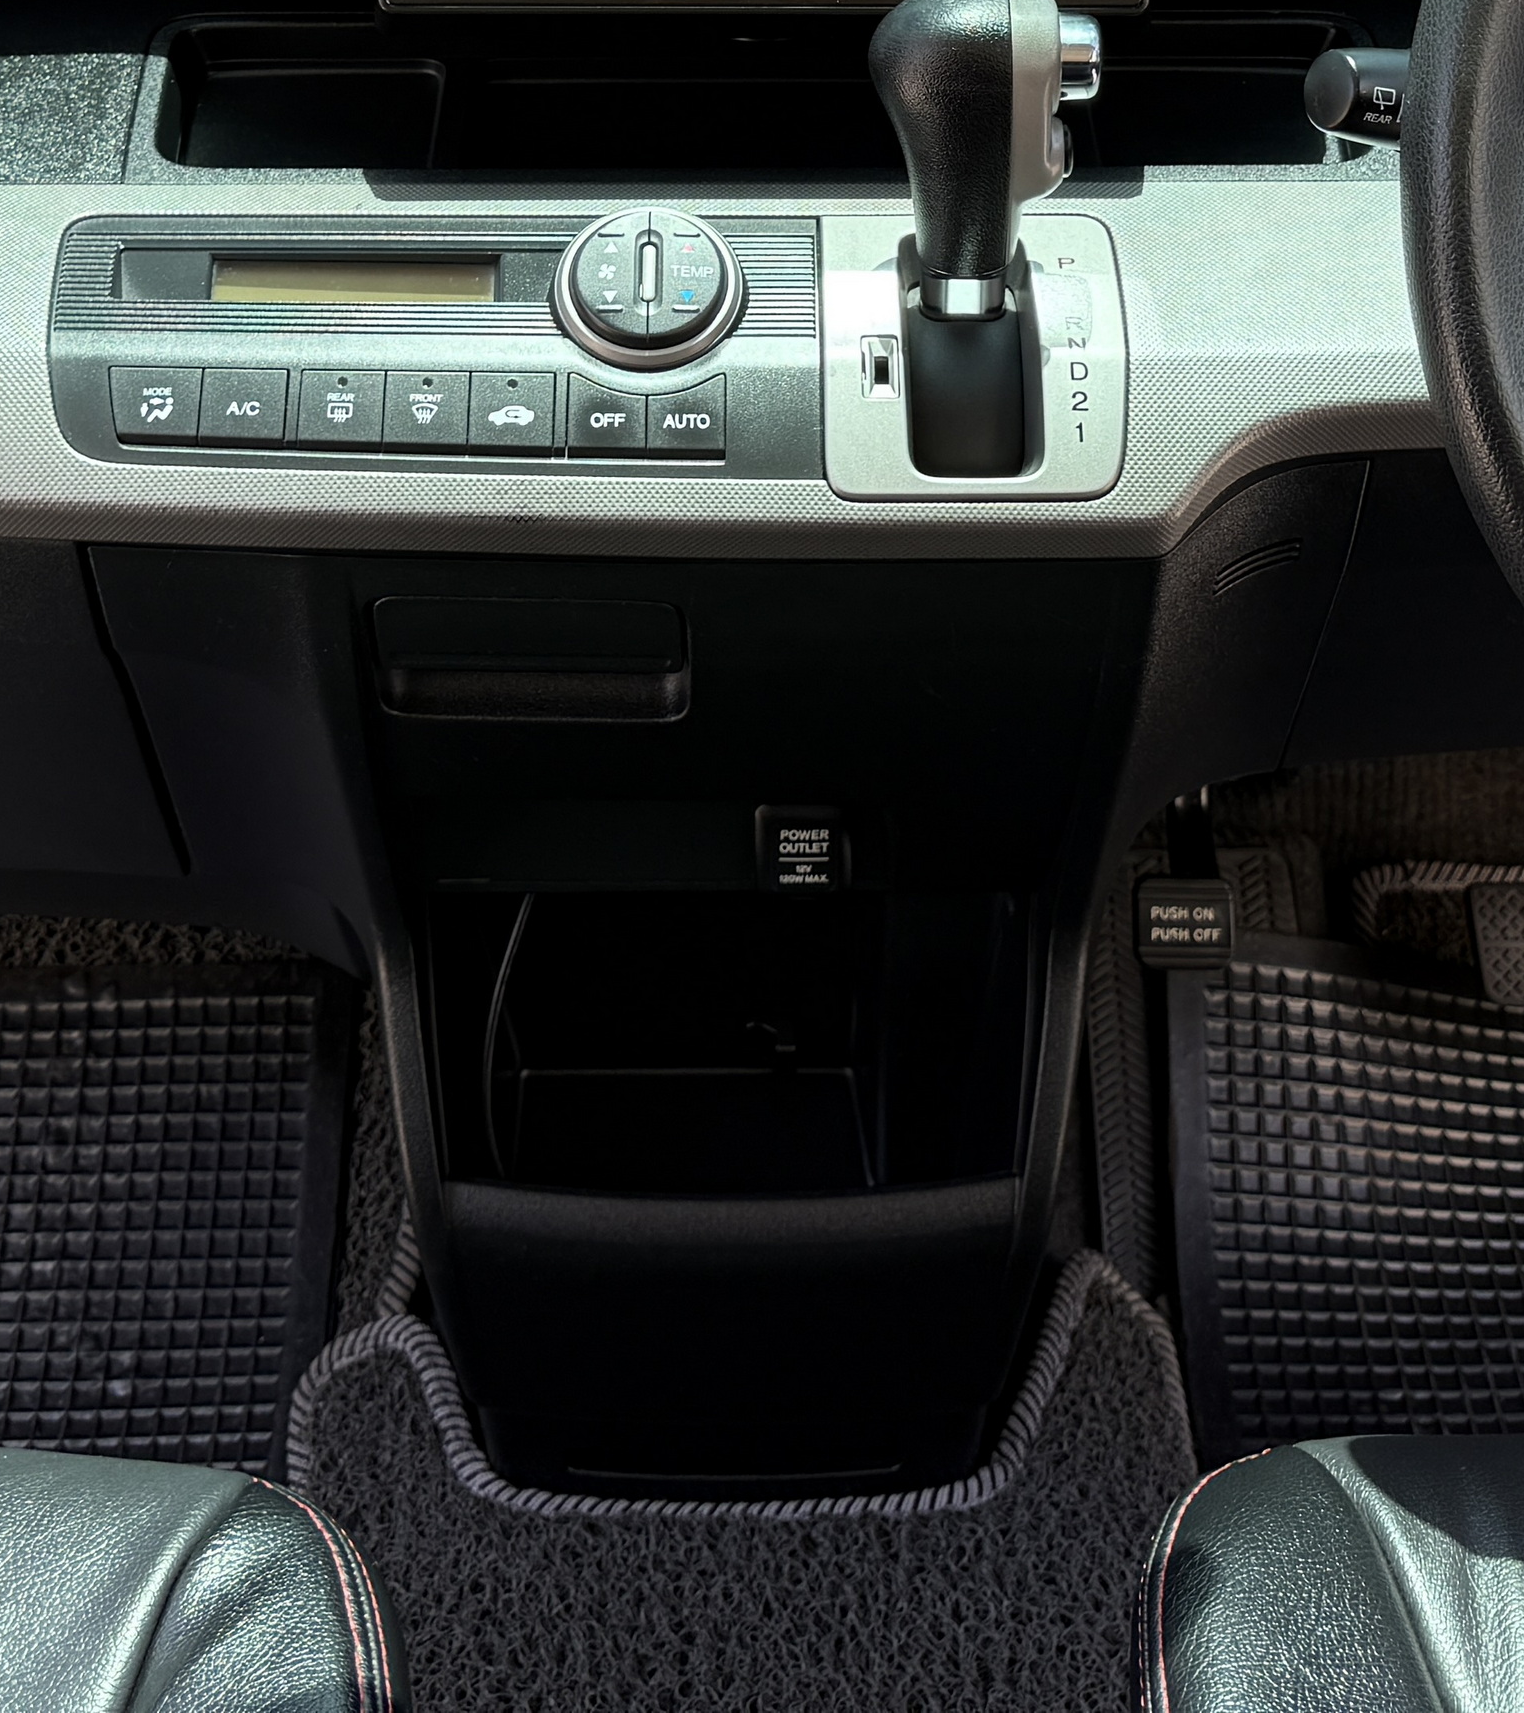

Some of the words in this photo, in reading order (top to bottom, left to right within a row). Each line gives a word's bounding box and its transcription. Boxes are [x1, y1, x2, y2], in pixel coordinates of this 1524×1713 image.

[1363, 112, 1392, 124] REAR
[1058, 258, 1075, 269] P
[670, 264, 714, 278] TEMP
[1068, 337, 1086, 349] N
[1070, 362, 1088, 380] D
[327, 393, 355, 401] REAR
[410, 394, 443, 402] FRONT
[1072, 391, 1089, 411] 2
[227, 401, 260, 416] A/C
[590, 413, 626, 428] OFF
[663, 414, 710, 429] AUTO
[1076, 422, 1083, 442] 1
[780, 829, 829, 841] POWER
[779, 842, 829, 853] OUTLET
[1150, 906, 1189, 921] PUSH
[1192, 907, 1214, 921] ON
[1151, 927, 1190, 942] PUSH
[1193, 928, 1222, 942] OFF
